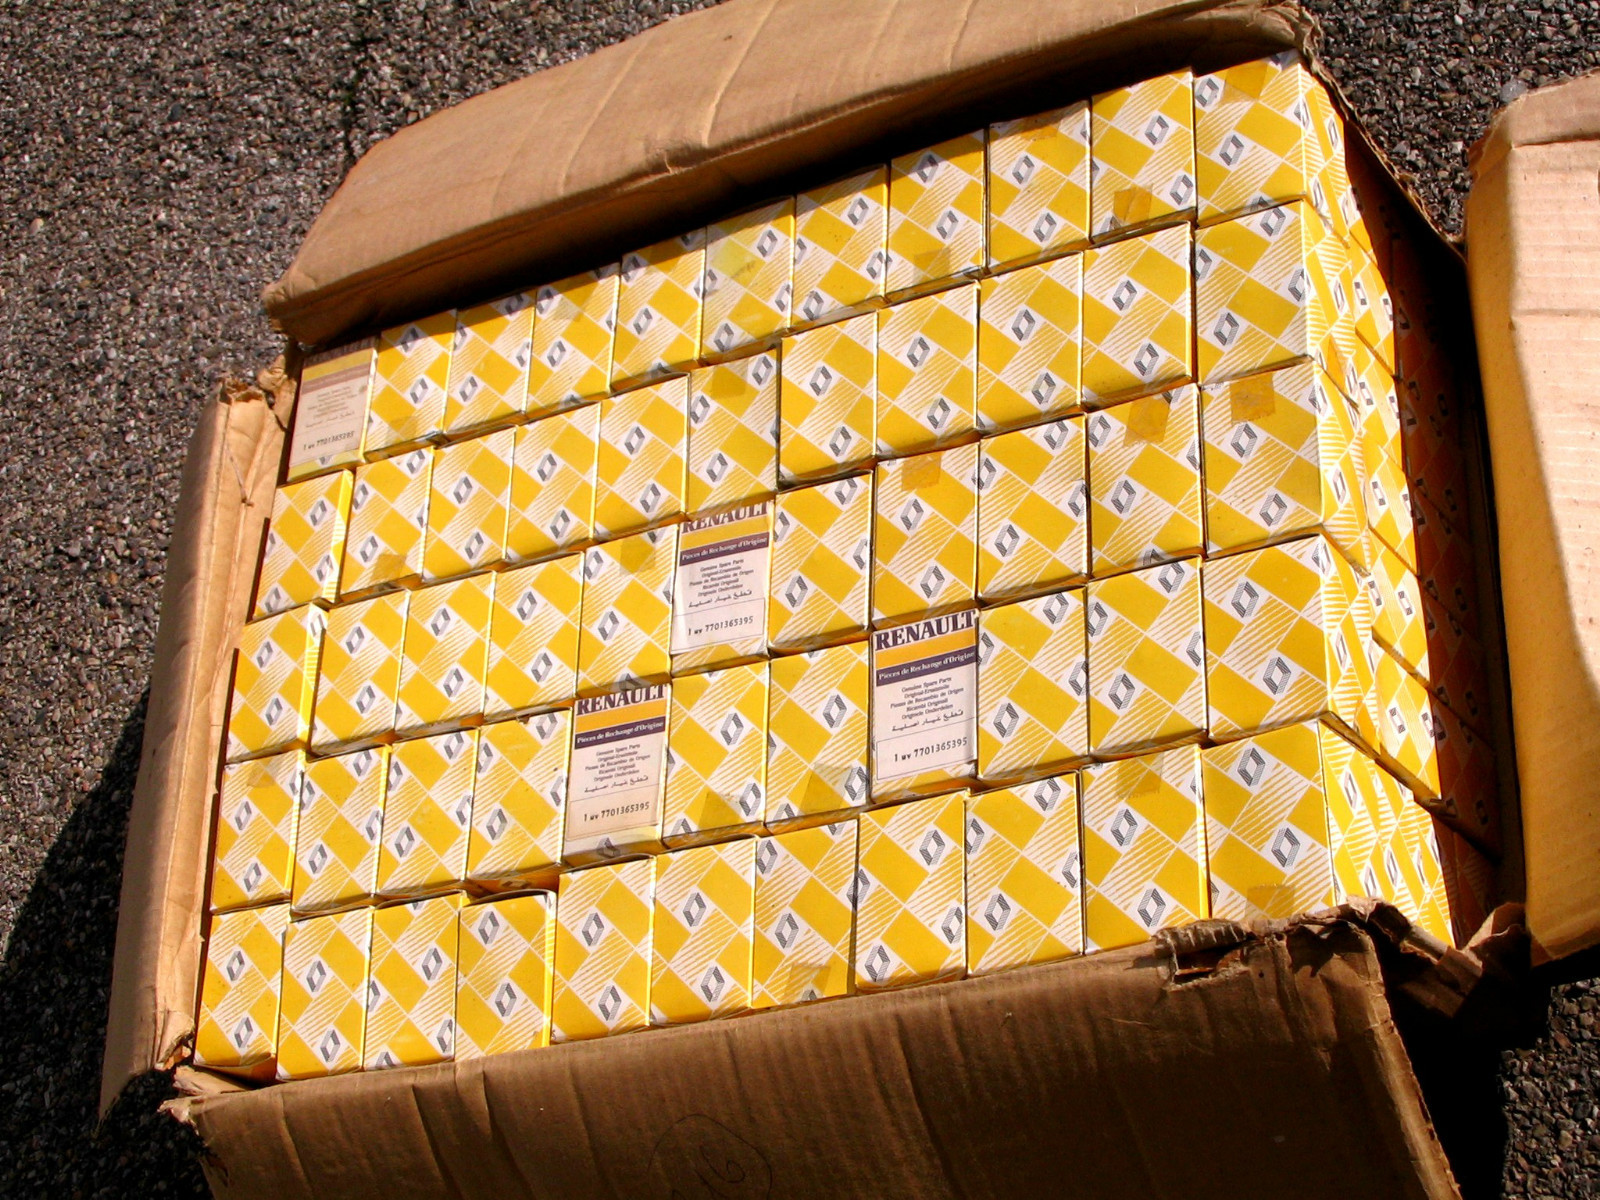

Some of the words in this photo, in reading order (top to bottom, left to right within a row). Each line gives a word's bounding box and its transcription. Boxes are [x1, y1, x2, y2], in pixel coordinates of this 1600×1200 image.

[682, 500, 770, 533] RENAULT
[705, 616, 753, 632] 7701365395
[876, 610, 975, 650] RENAULT
[911, 661, 942, 673] Rechange
[944, 653, 974, 664] d'Origine
[577, 684, 667, 715] RENAULT
[914, 737, 967, 757] 7701365395
[601, 802, 649, 817] 7701365395
